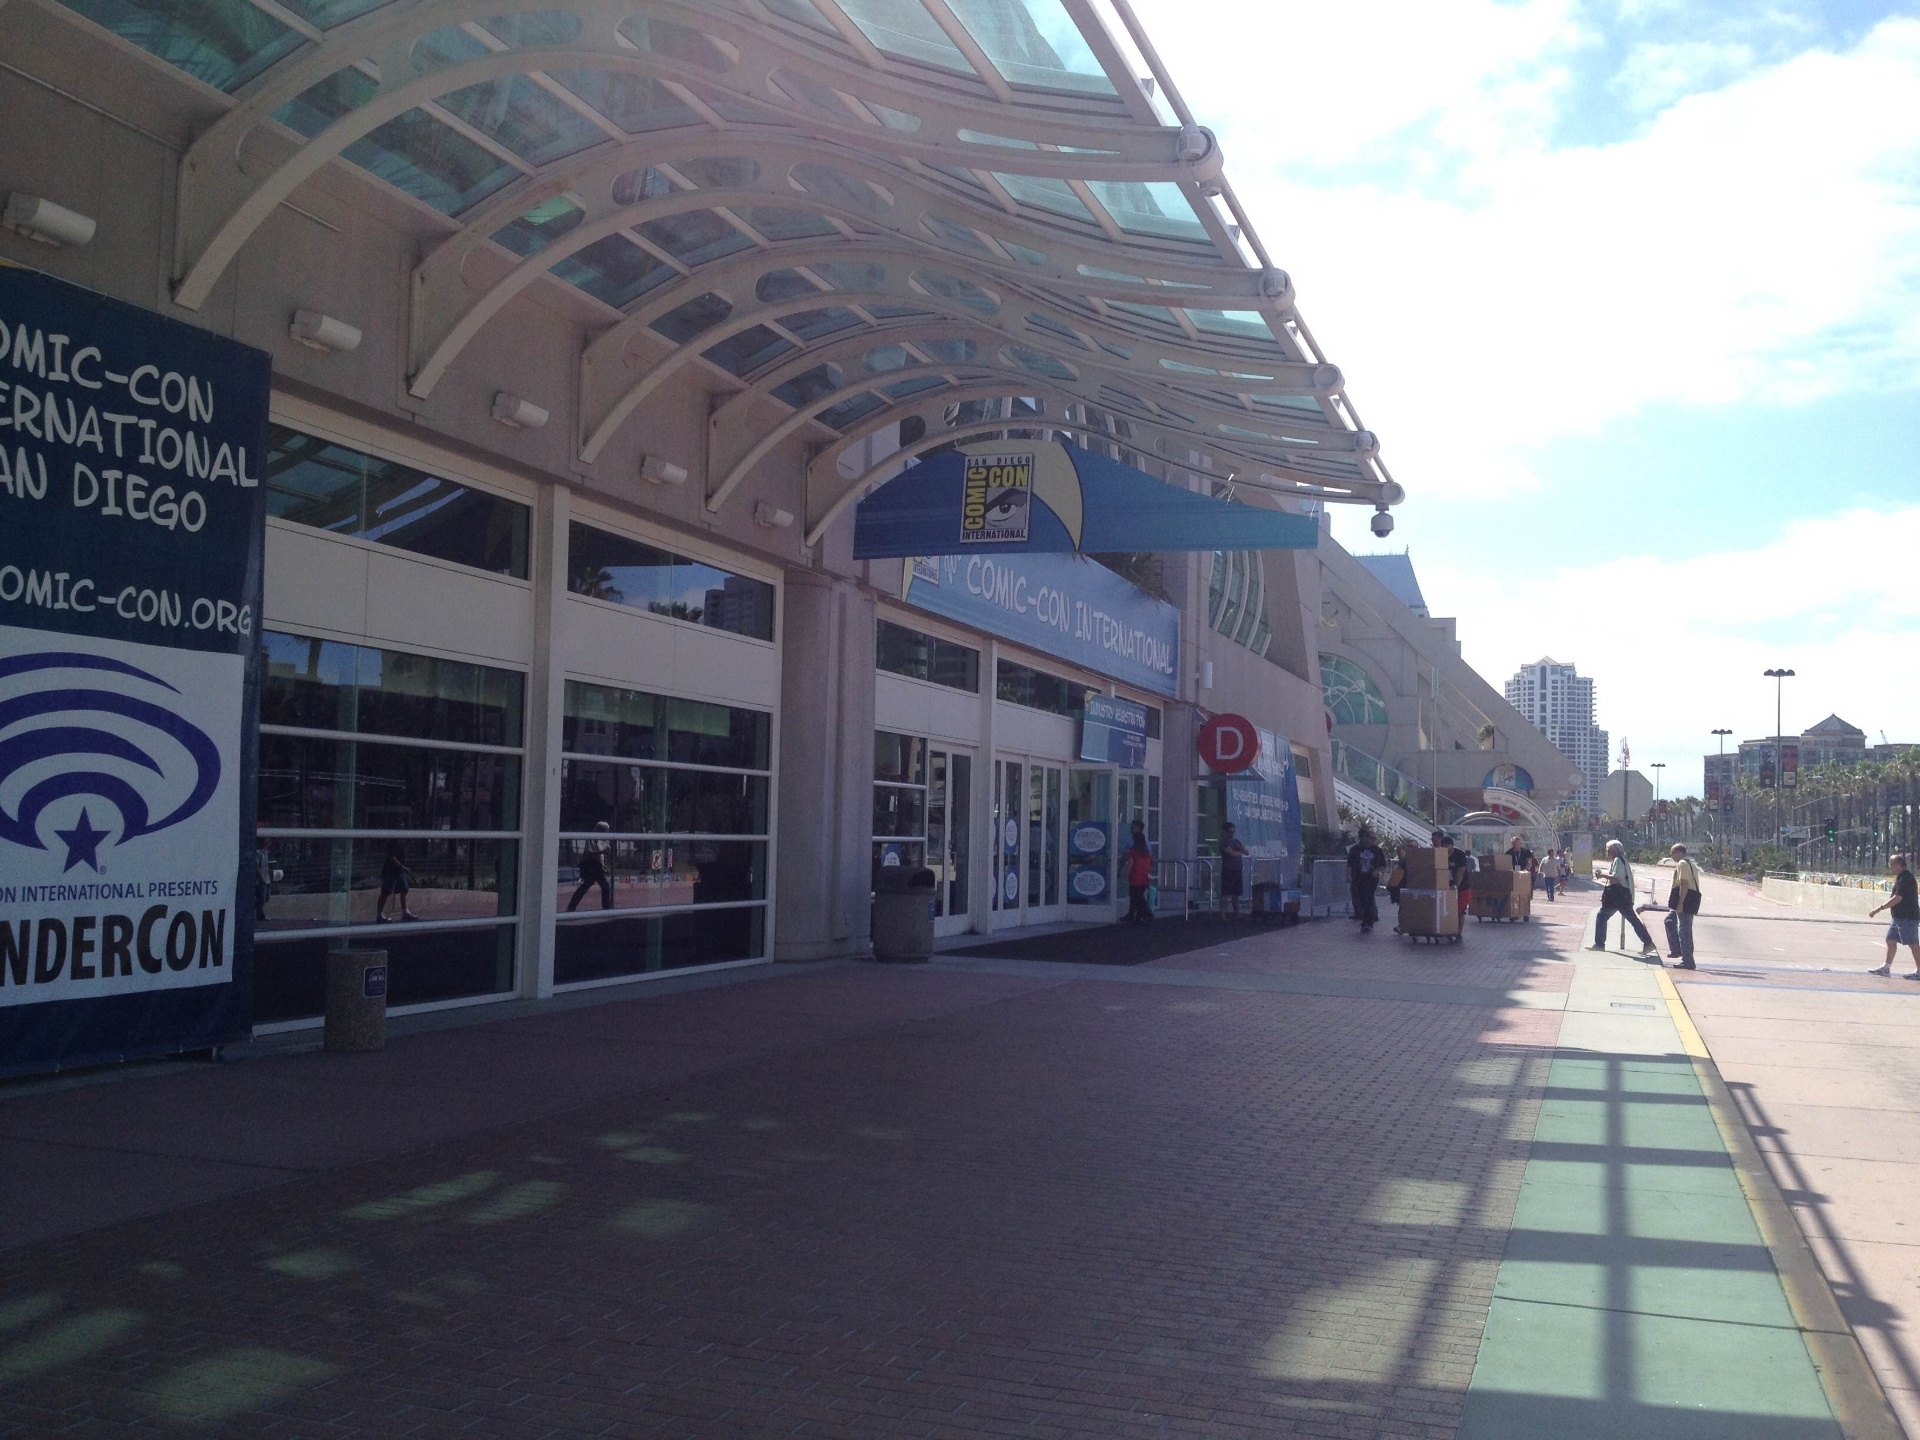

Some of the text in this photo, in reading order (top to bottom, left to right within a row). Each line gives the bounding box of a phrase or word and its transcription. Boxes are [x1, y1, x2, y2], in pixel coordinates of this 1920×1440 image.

[967, 456, 1031, 467] SAN DIEGO
[988, 465, 1029, 488] CON
[73, 461, 207, 532] DIEGO
[964, 467, 987, 530] COMIC
[962, 529, 1026, 540] INTERNATIONAL
[966, 554, 1173, 675] COMIC-CON INTERNATIONAL
[1216, 726, 1244, 760] D
[22, 883, 144, 902] INTERNATIONAL
[149, 880, 218, 897] PRESENTS
